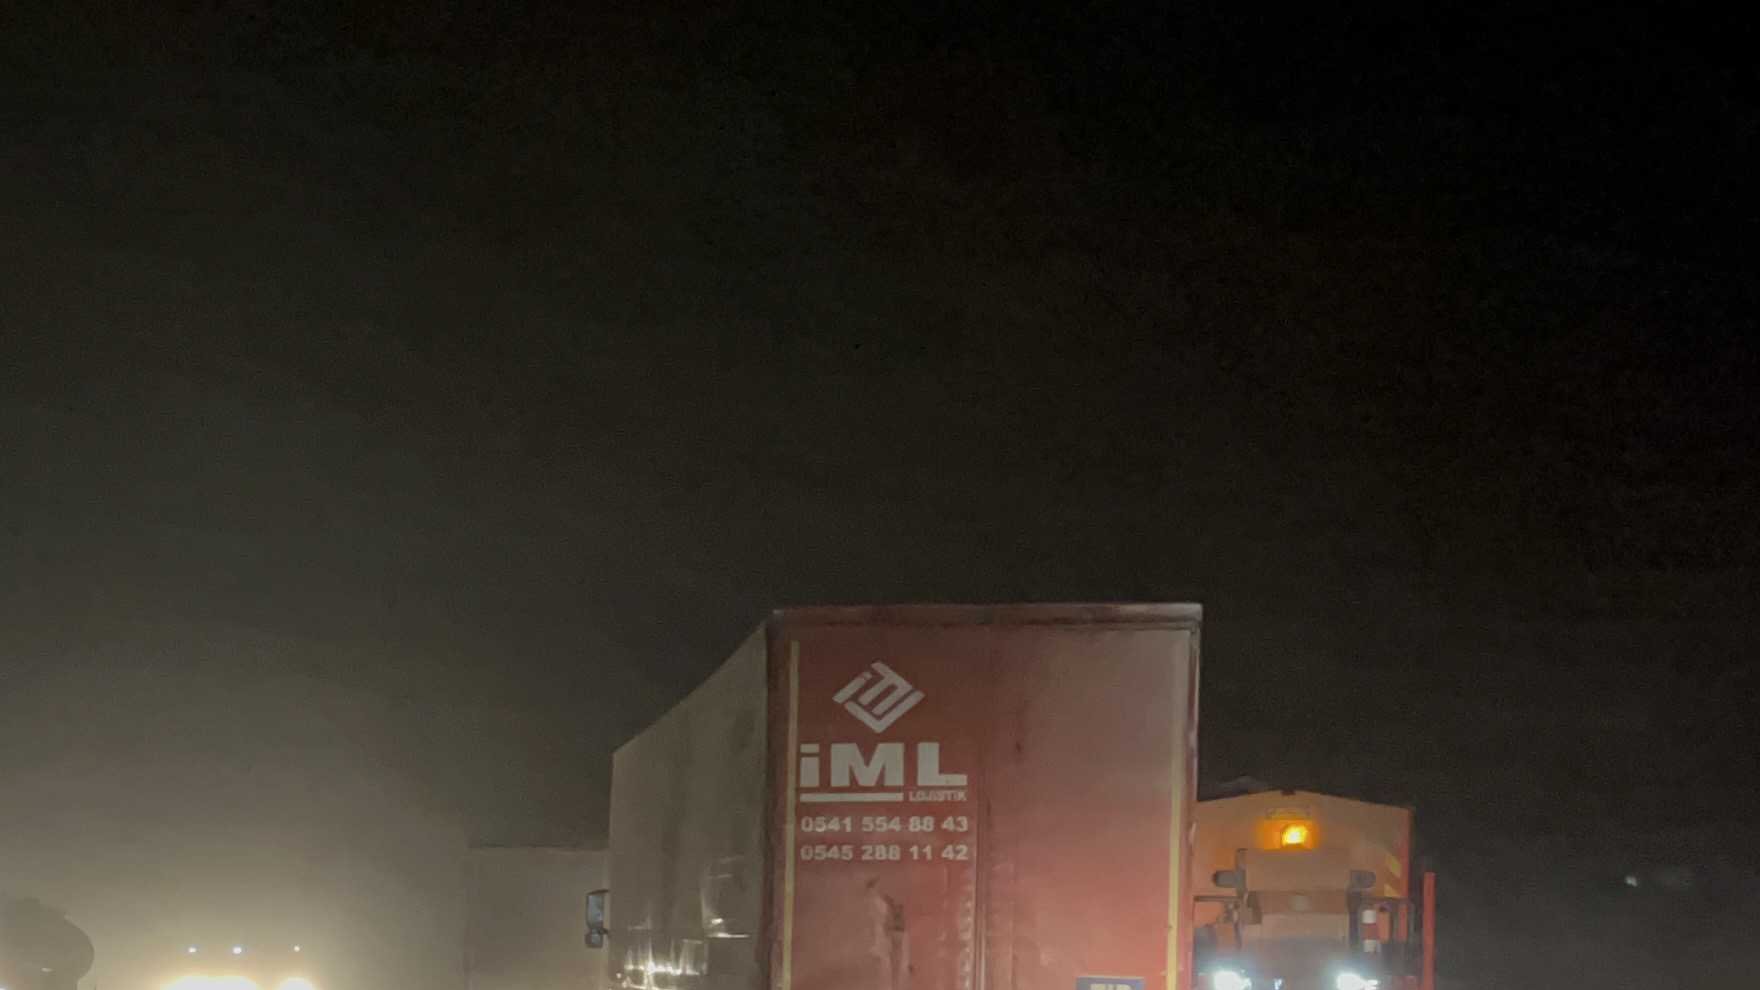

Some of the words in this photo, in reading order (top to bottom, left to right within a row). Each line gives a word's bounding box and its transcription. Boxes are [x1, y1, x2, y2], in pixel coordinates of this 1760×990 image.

[800, 816, 852, 832] 0541
[862, 816, 900, 832] 554
[941, 816, 968, 832] 43
[800, 845, 853, 860] 0545
[862, 845, 900, 860] 288
[910, 845, 932, 860] 11
[941, 845, 968, 860] 42
